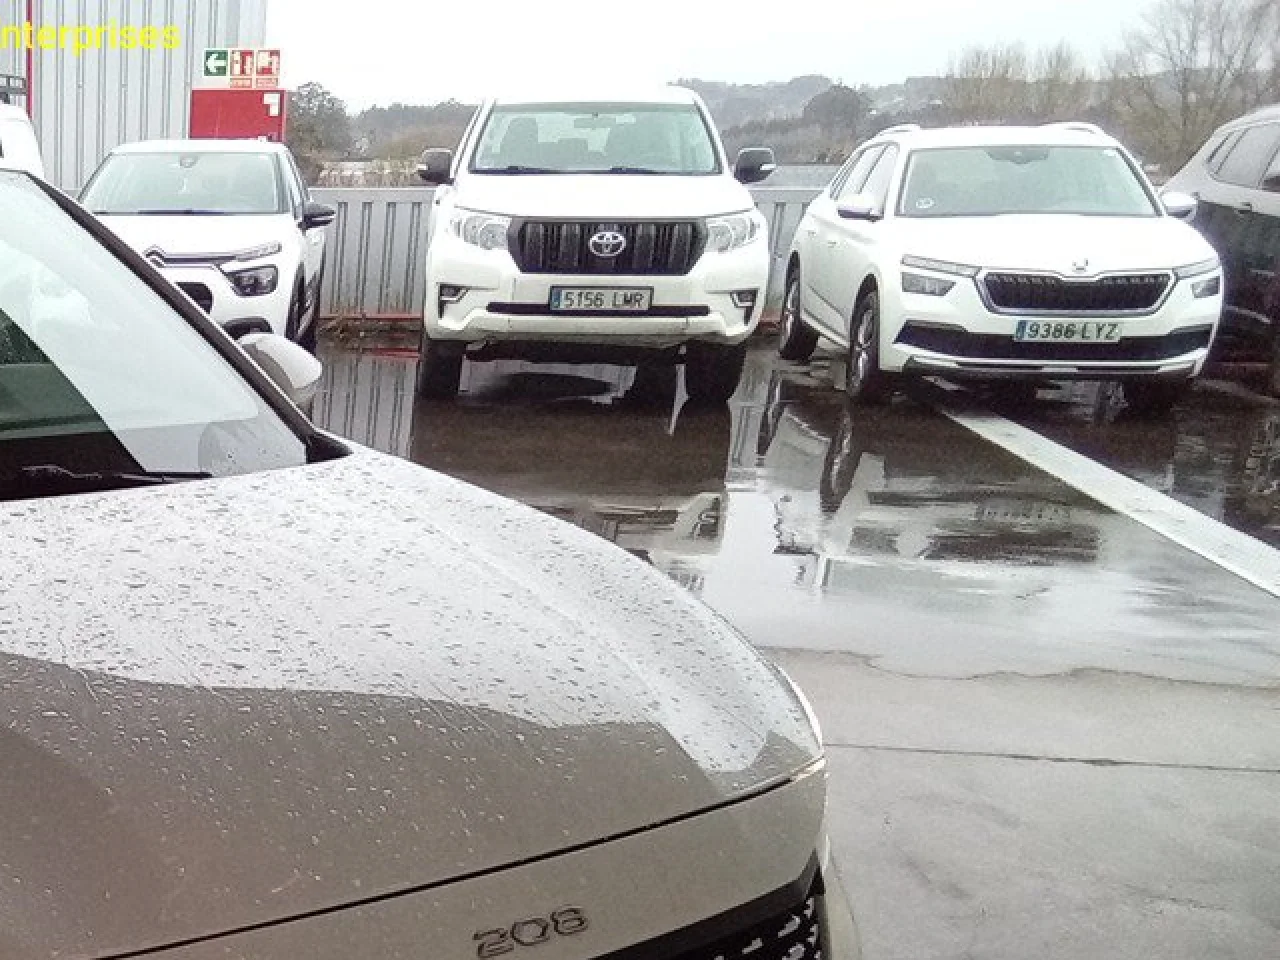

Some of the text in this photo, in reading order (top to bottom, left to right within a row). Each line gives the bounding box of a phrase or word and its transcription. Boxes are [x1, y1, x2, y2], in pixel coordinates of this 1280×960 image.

[565, 291, 645, 308] 5156 LMR
[1028, 322, 1119, 340] 9386 LYZ
[472, 904, 588, 959] 208
